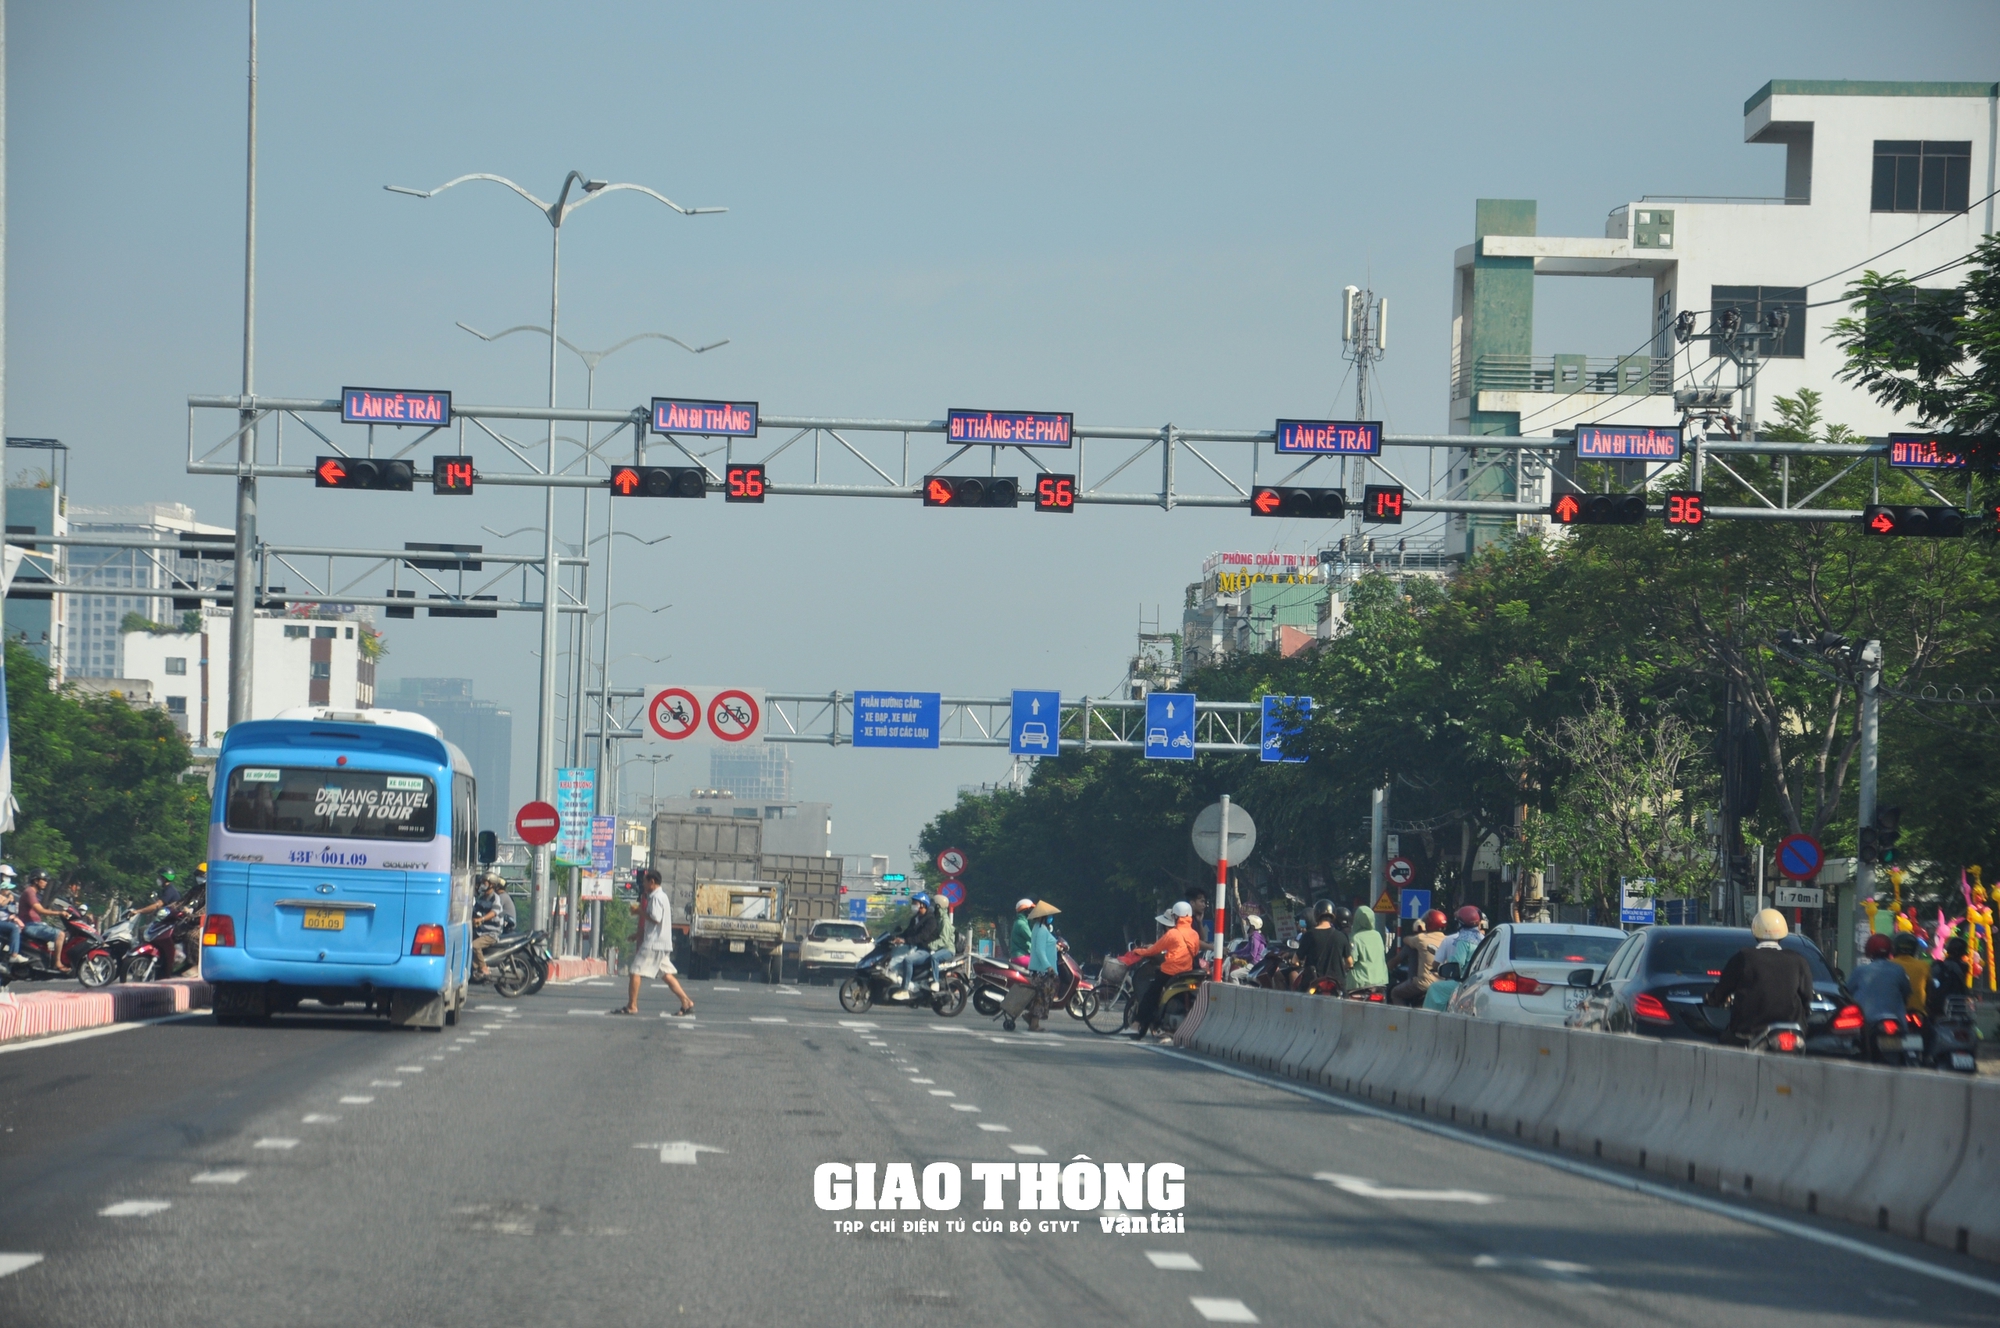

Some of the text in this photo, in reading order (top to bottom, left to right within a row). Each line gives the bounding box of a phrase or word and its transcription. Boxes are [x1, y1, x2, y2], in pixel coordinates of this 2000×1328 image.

[352, 392, 441, 420] LÀN RẼ TRÁI
[658, 403, 688, 428] LÀN
[689, 409, 703, 429] ĐI
[951, 417, 964, 438] ĐI
[1035, 415, 1069, 441] PHẢI
[1285, 424, 1371, 450] LÀN RẼ TRÁI
[1582, 430, 1611, 454] LÀN
[1613, 434, 1626, 454] ĐI
[1893, 442, 1907, 462] ĐI
[446, 463, 471, 487] 14
[728, 469, 763, 497] 56
[1039, 479, 1072, 507] 56
[1377, 493, 1401, 516] 14
[1669, 496, 1702, 523] 36
[865, 712, 873, 722] XE
[892, 713, 900, 723] XE
[901, 711, 917, 723] MÁY
[864, 726, 873, 736] XE
[899, 725, 913, 738] CÁC
[914, 727, 929, 740] LOẠI
[315, 787, 429, 809] DANANG TRAVEL
[314, 802, 414, 820] OPEN TOUR
[288, 850, 367, 866] 43F 001.09
[308, 918, 340, 929] 001.09
